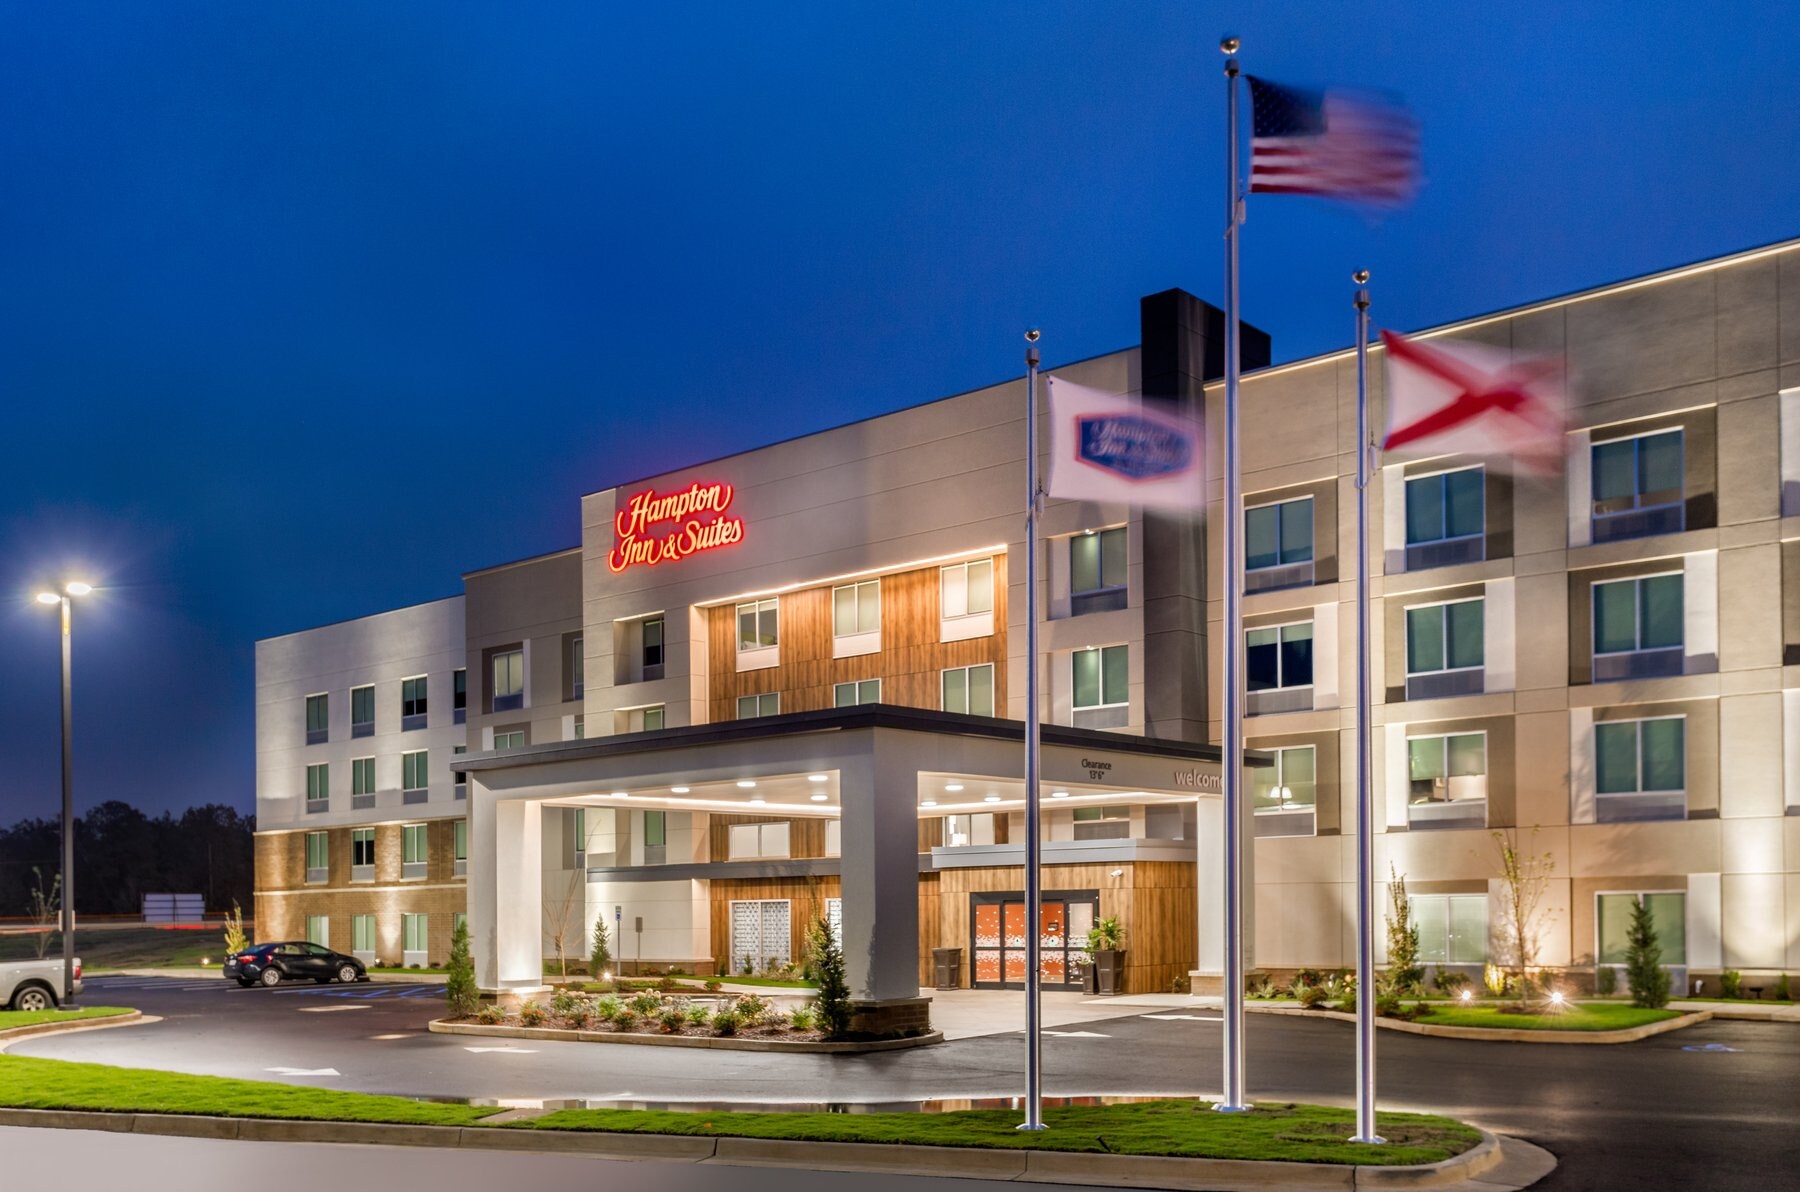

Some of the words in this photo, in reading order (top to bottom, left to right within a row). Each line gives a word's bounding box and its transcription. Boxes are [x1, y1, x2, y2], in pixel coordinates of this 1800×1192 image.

[616, 483, 732, 538] Hampton
[609, 534, 664, 572] Inn
[662, 533, 681, 560] &
[677, 516, 742, 555] Suites
[1081, 758, 1112, 770] Clearance
